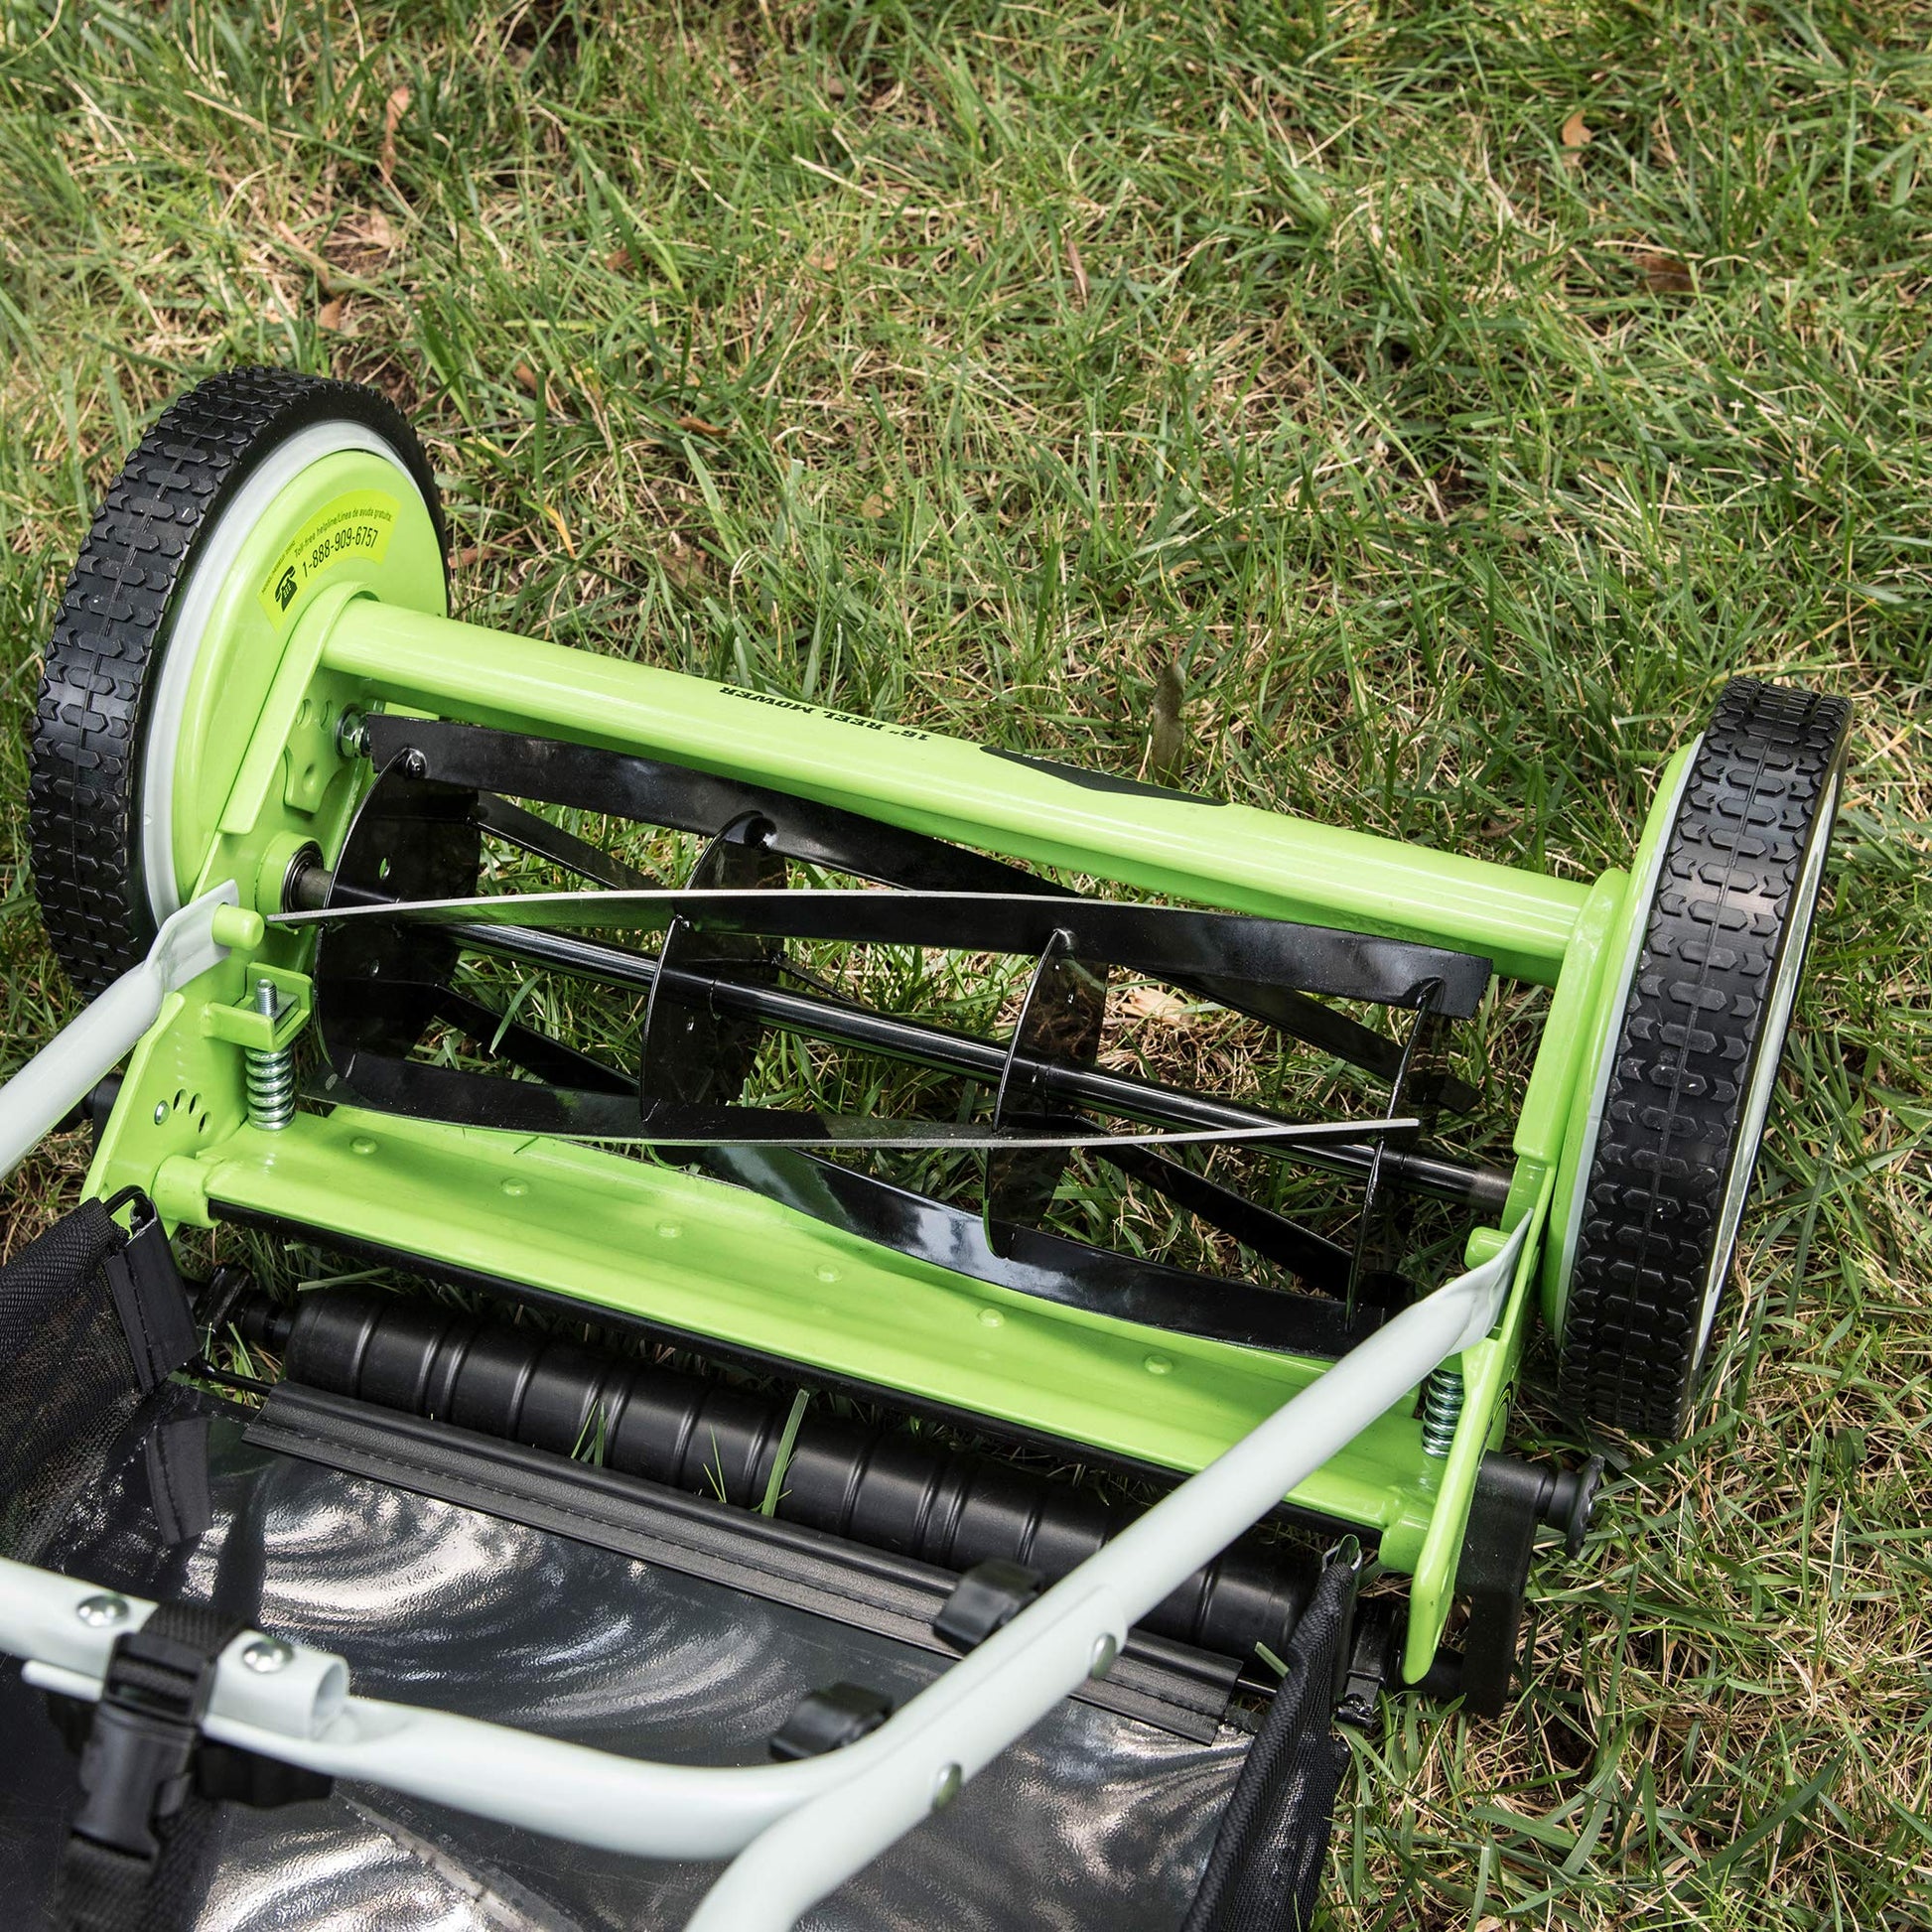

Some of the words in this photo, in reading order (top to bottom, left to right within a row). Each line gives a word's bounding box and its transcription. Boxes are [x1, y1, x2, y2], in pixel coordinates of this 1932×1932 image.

[294, 531, 316, 558] Toll-free
[351, 507, 359, 518] de
[302, 525, 378, 578] 1-888-909-6757
[719, 686, 818, 715] MOWER
[822, 710, 886, 732] REEL
